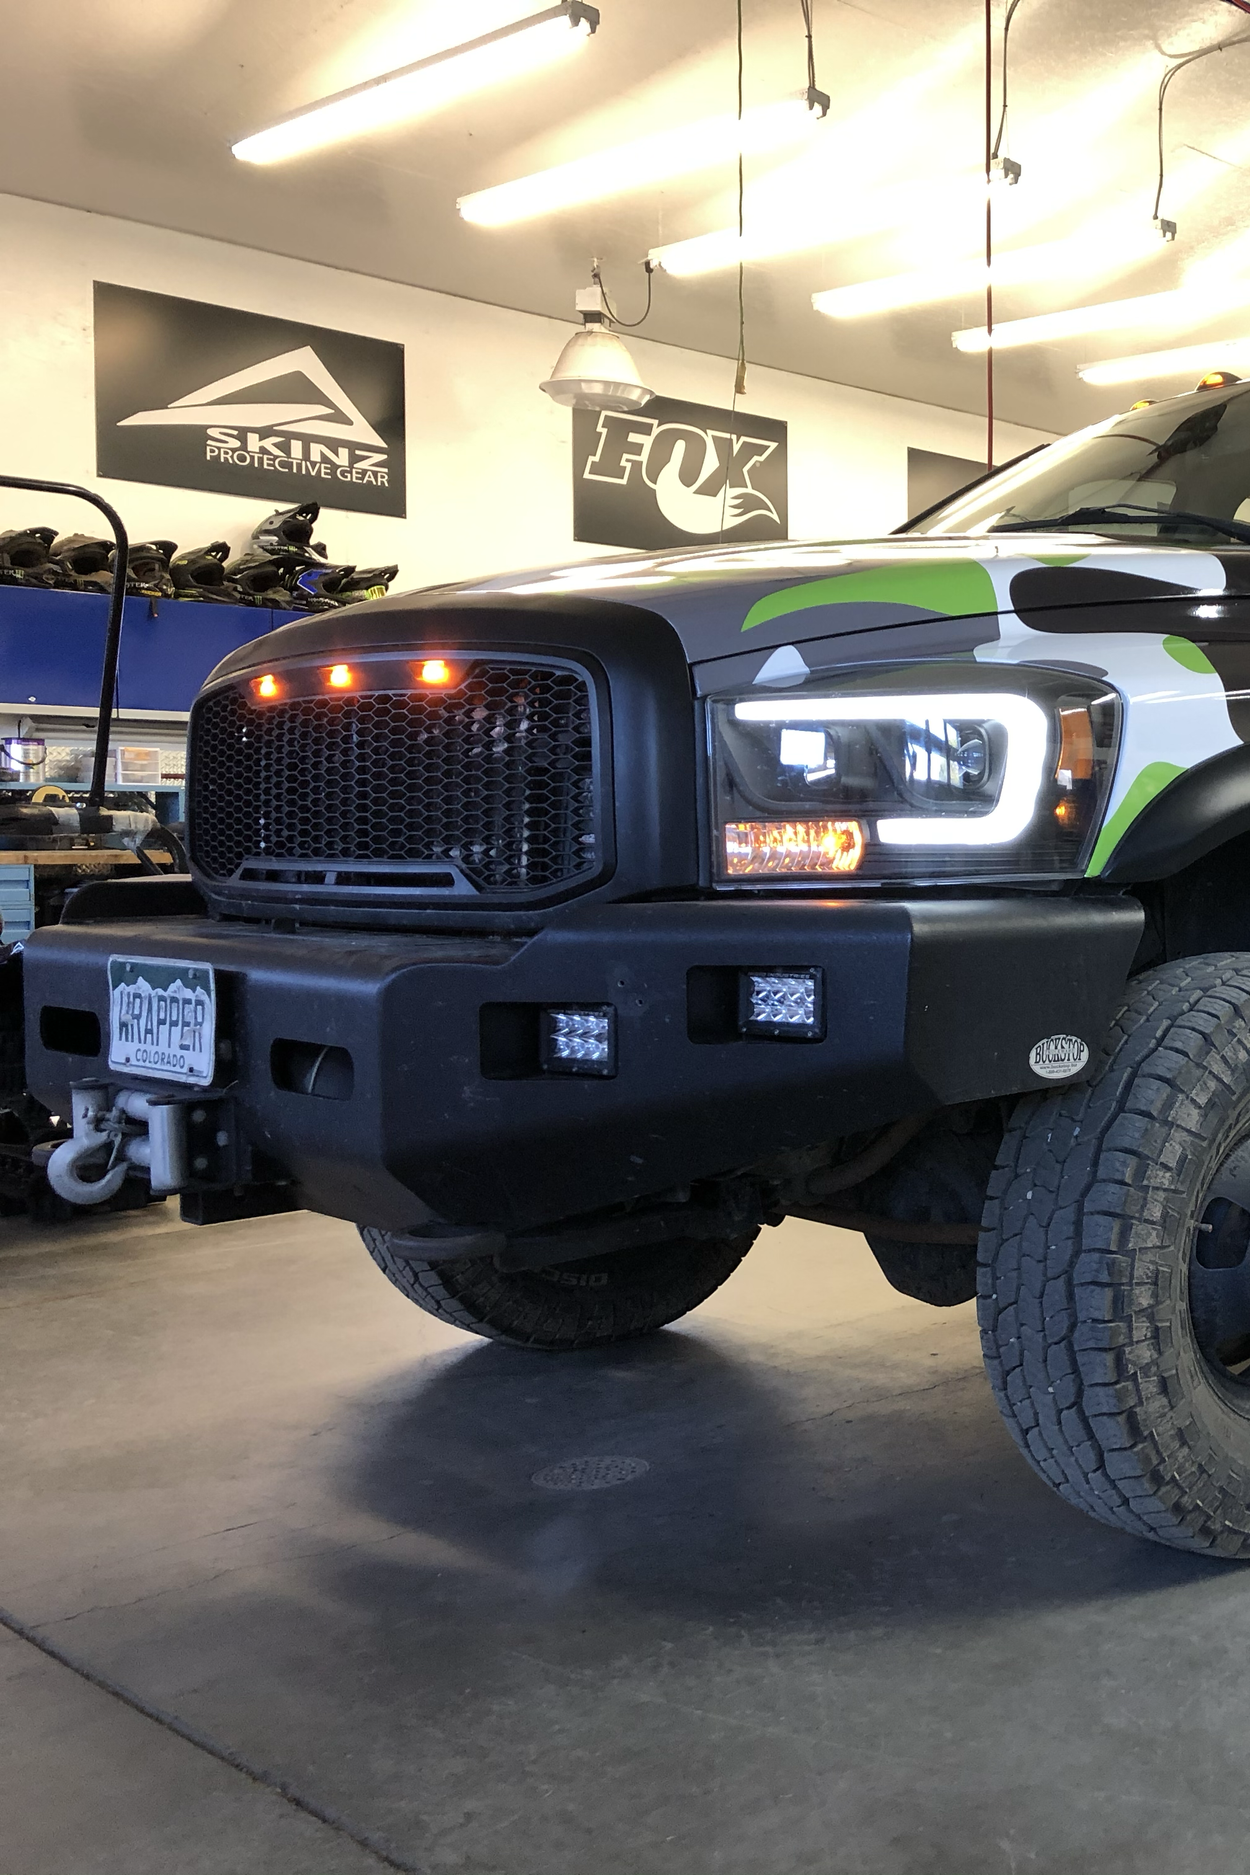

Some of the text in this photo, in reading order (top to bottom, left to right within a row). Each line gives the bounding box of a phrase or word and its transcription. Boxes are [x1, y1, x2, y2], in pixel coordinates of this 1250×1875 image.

[205, 426, 389, 473] SKINZ
[205, 445, 389, 487] PROTECTIVE GEAR
[583, 410, 780, 521] FOX
[118, 990, 205, 1053] WRAPPER
[135, 1048, 185, 1069] COLORADO
[1034, 1036, 1085, 1064] BUCKSTOP
